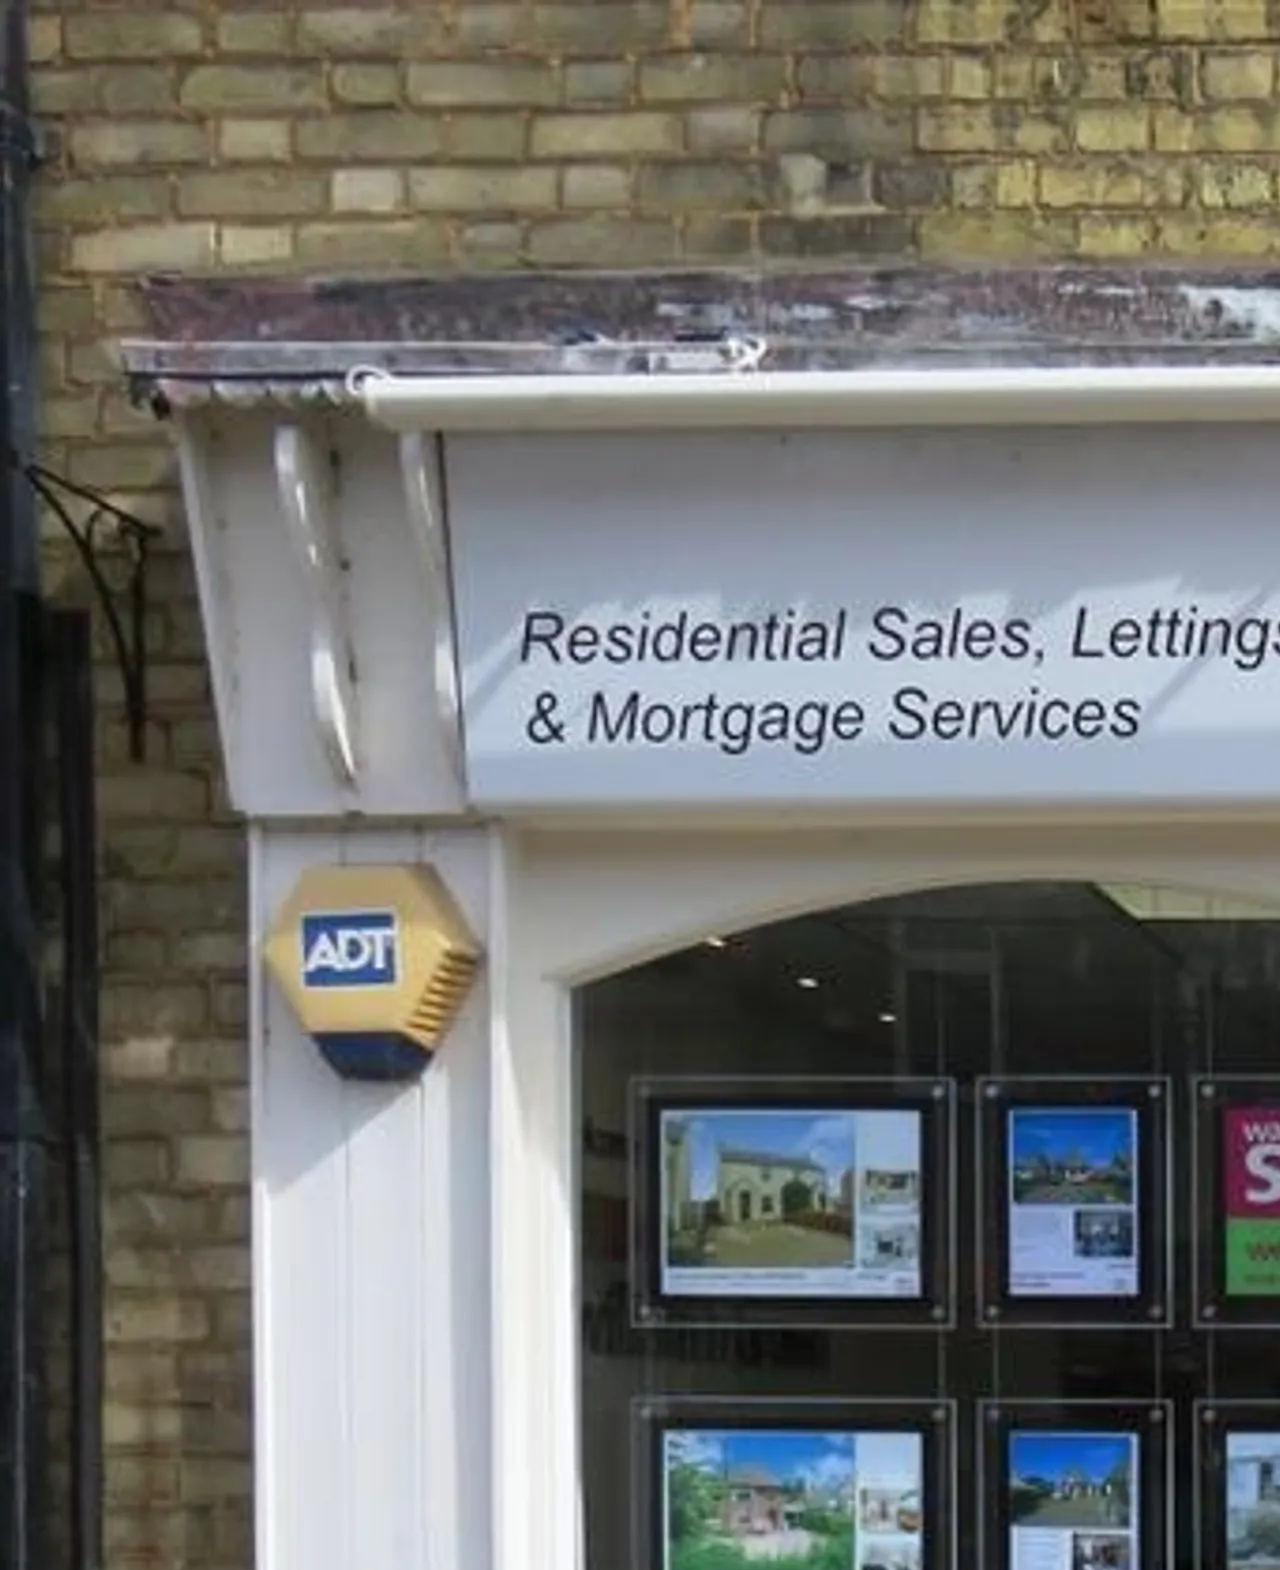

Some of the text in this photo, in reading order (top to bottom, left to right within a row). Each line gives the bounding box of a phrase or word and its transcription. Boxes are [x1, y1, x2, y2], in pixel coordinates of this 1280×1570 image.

[519, 609, 846, 665] Residential
[867, 607, 1047, 667] Sales,
[527, 687, 1143, 754] & Mortgage Services
[301, 928, 394, 972] ADT
